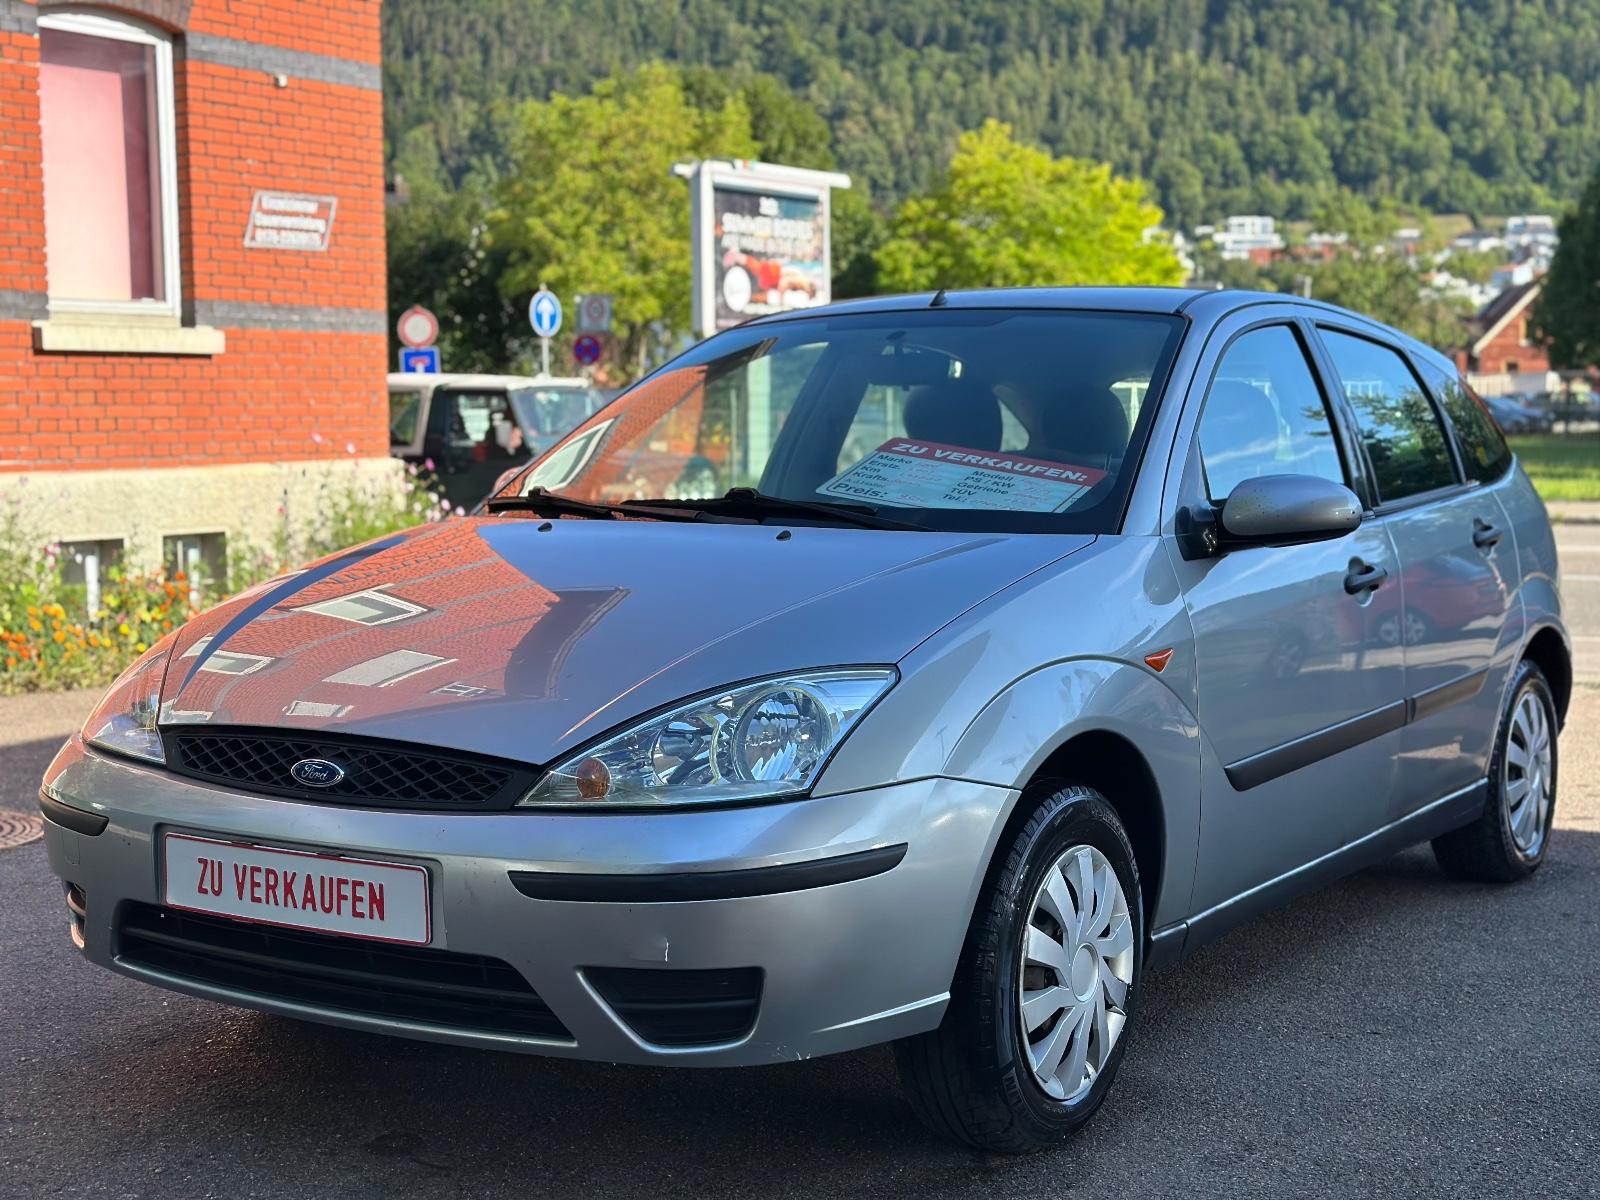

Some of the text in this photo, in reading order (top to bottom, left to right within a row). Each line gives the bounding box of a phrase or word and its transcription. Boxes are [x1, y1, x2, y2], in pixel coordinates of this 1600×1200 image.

[877, 454, 912, 464] Marke
[892, 443, 1088, 482] ZU VERKAUFEN:
[972, 470, 1014, 481] Modell
[832, 483, 888, 498] Preis:
[957, 482, 1009, 495] Getriebe
[301, 763, 329, 781] Ford
[197, 857, 385, 921] ZU VERKAUFEN
